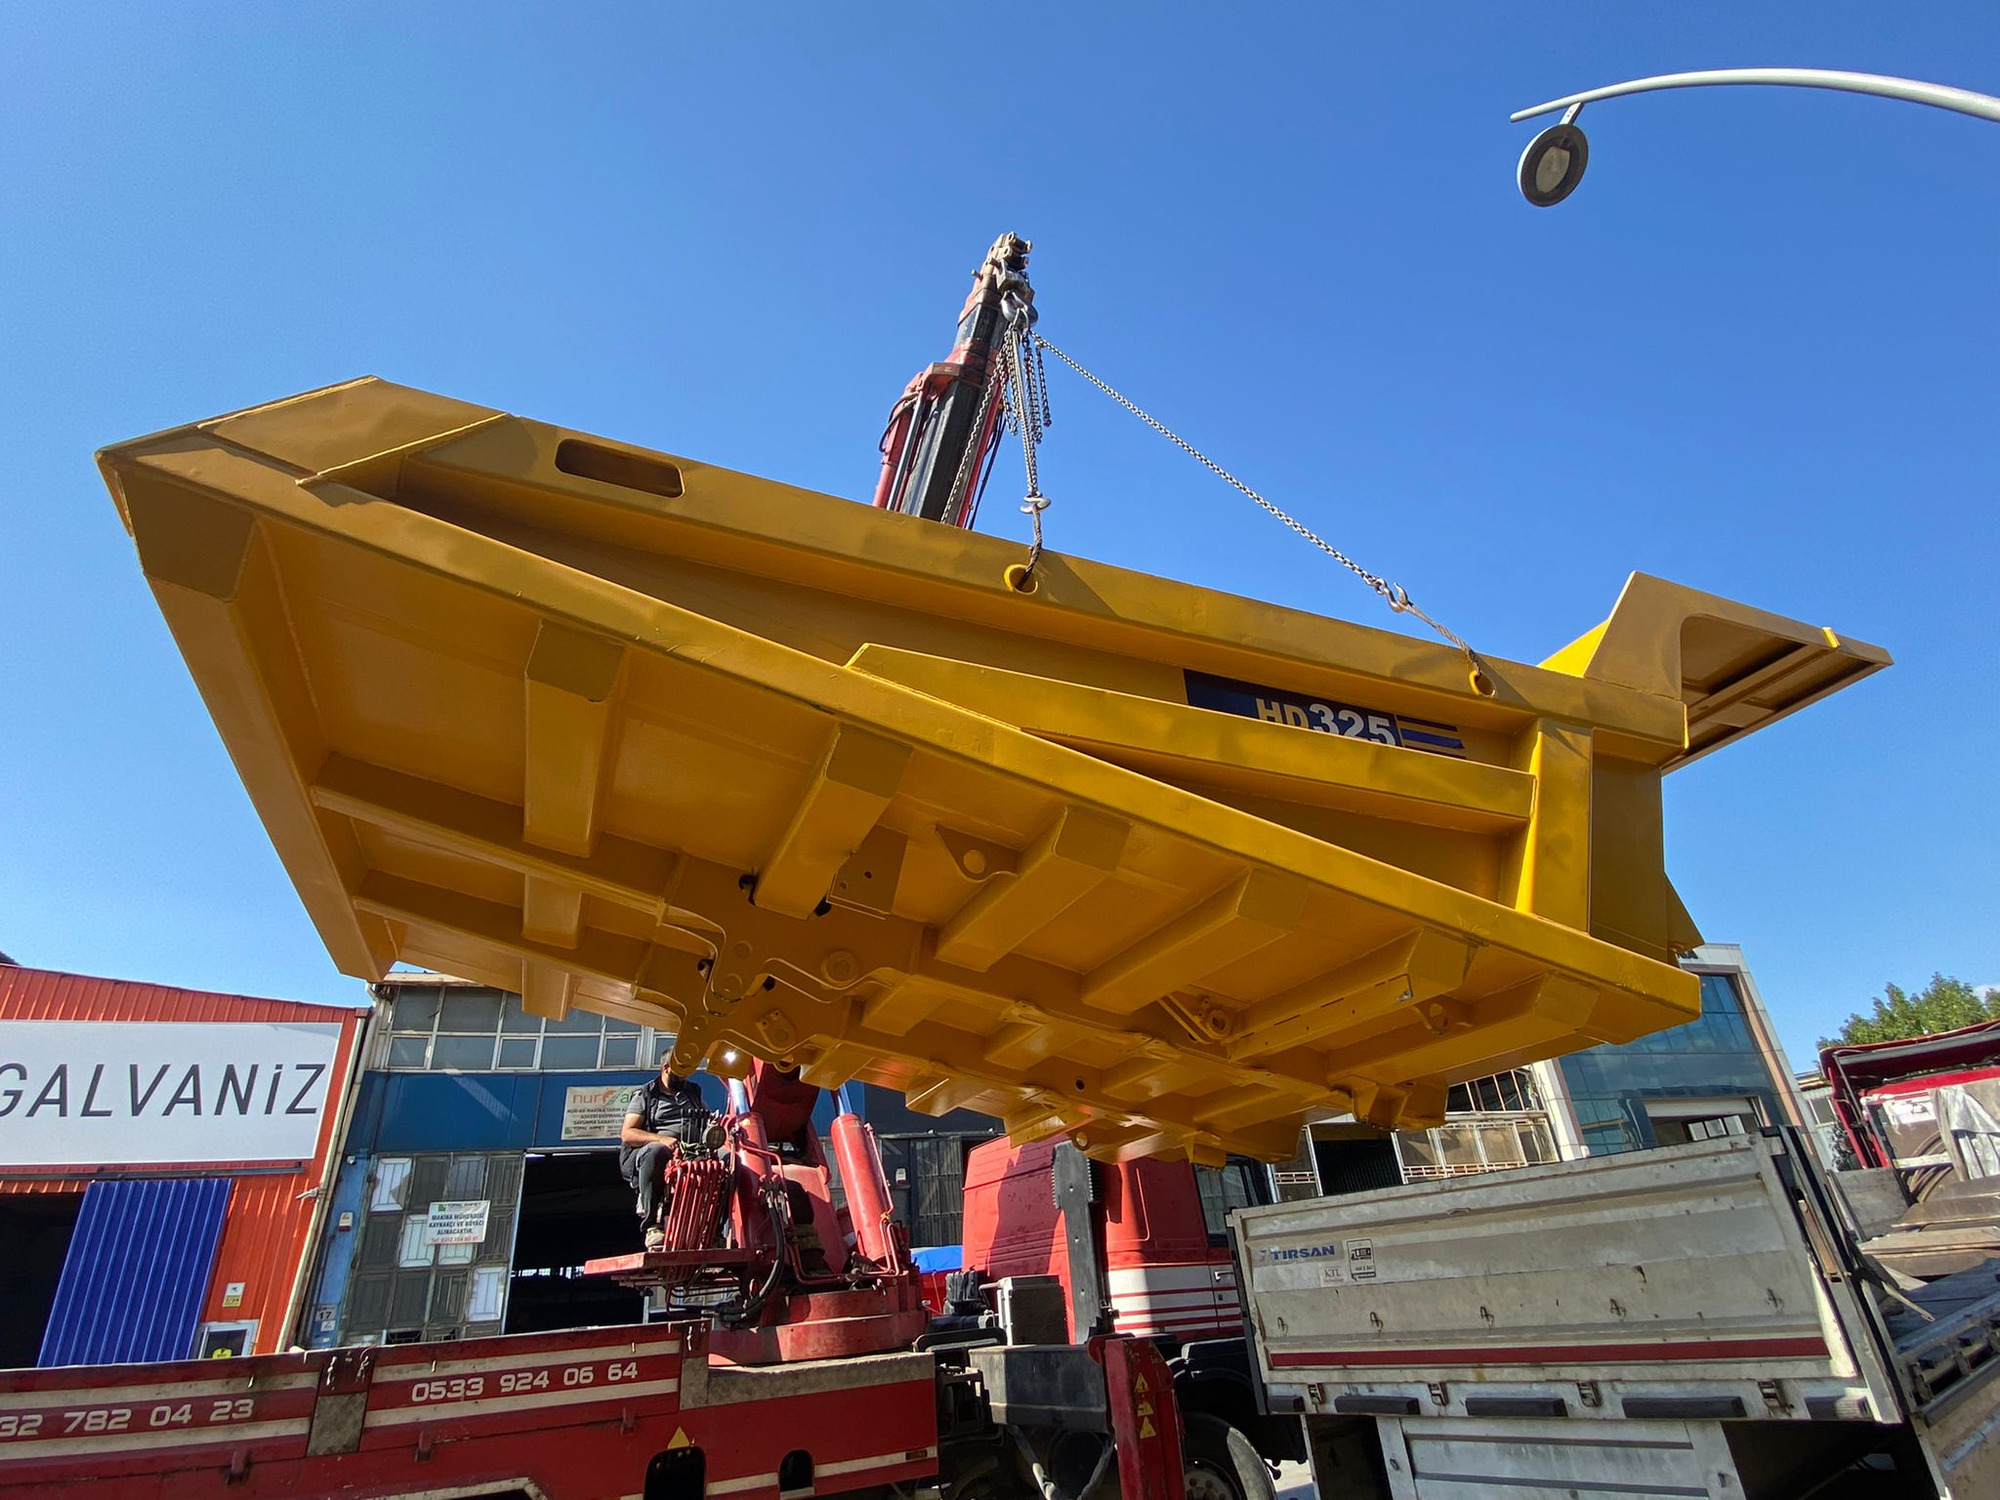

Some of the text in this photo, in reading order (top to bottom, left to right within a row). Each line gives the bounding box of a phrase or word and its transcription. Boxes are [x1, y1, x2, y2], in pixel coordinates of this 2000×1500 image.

[1255, 698, 1396, 747] HD325
[1271, 1245, 1336, 1260] TIRSAN
[1324, 1268, 1342, 1278] KTL
[412, 1362, 638, 1402] 0533 924 06 64
[64, 1408, 132, 1433] 782
[150, 1404, 192, 1426] 04
[210, 1399, 254, 1422] 23
